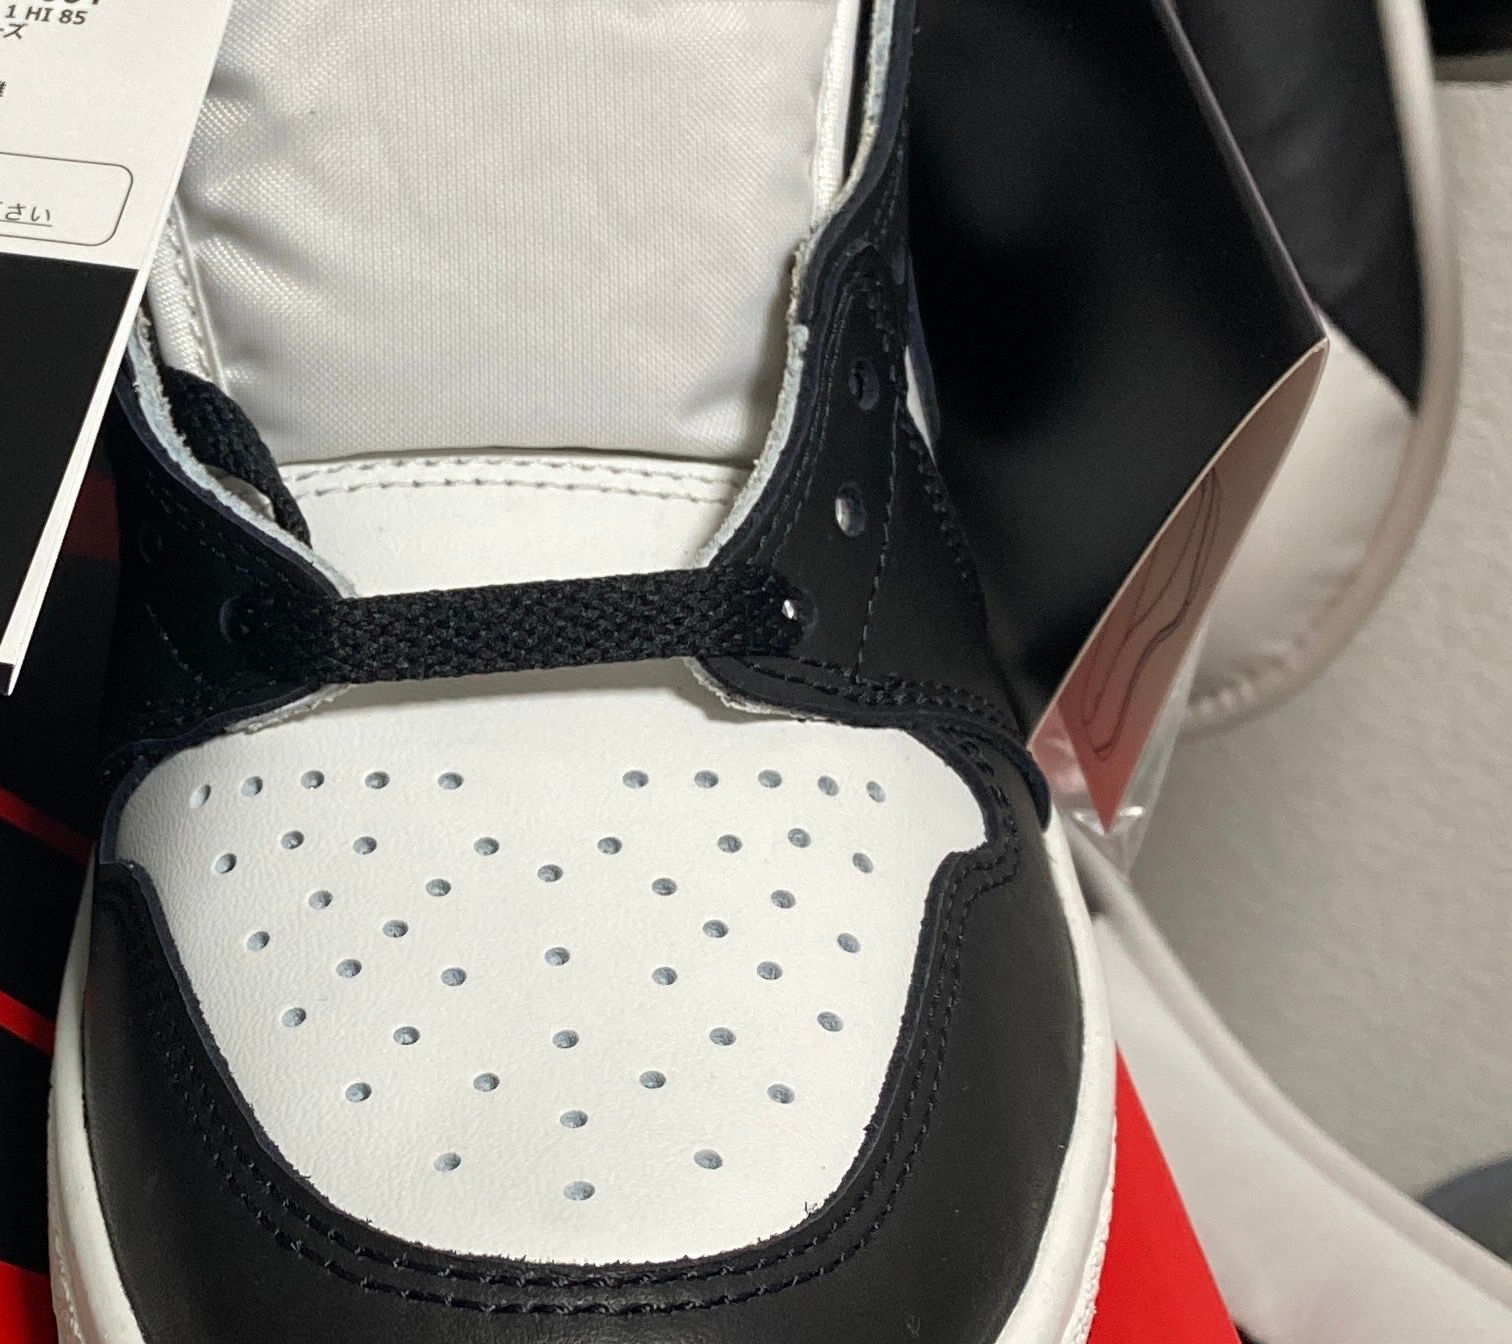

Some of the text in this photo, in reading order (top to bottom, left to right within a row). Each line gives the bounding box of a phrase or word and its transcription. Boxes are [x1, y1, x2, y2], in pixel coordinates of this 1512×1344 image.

[5, 4, 17, 19] 1
[25, 6, 54, 22] HI
[59, 9, 88, 25] 85
